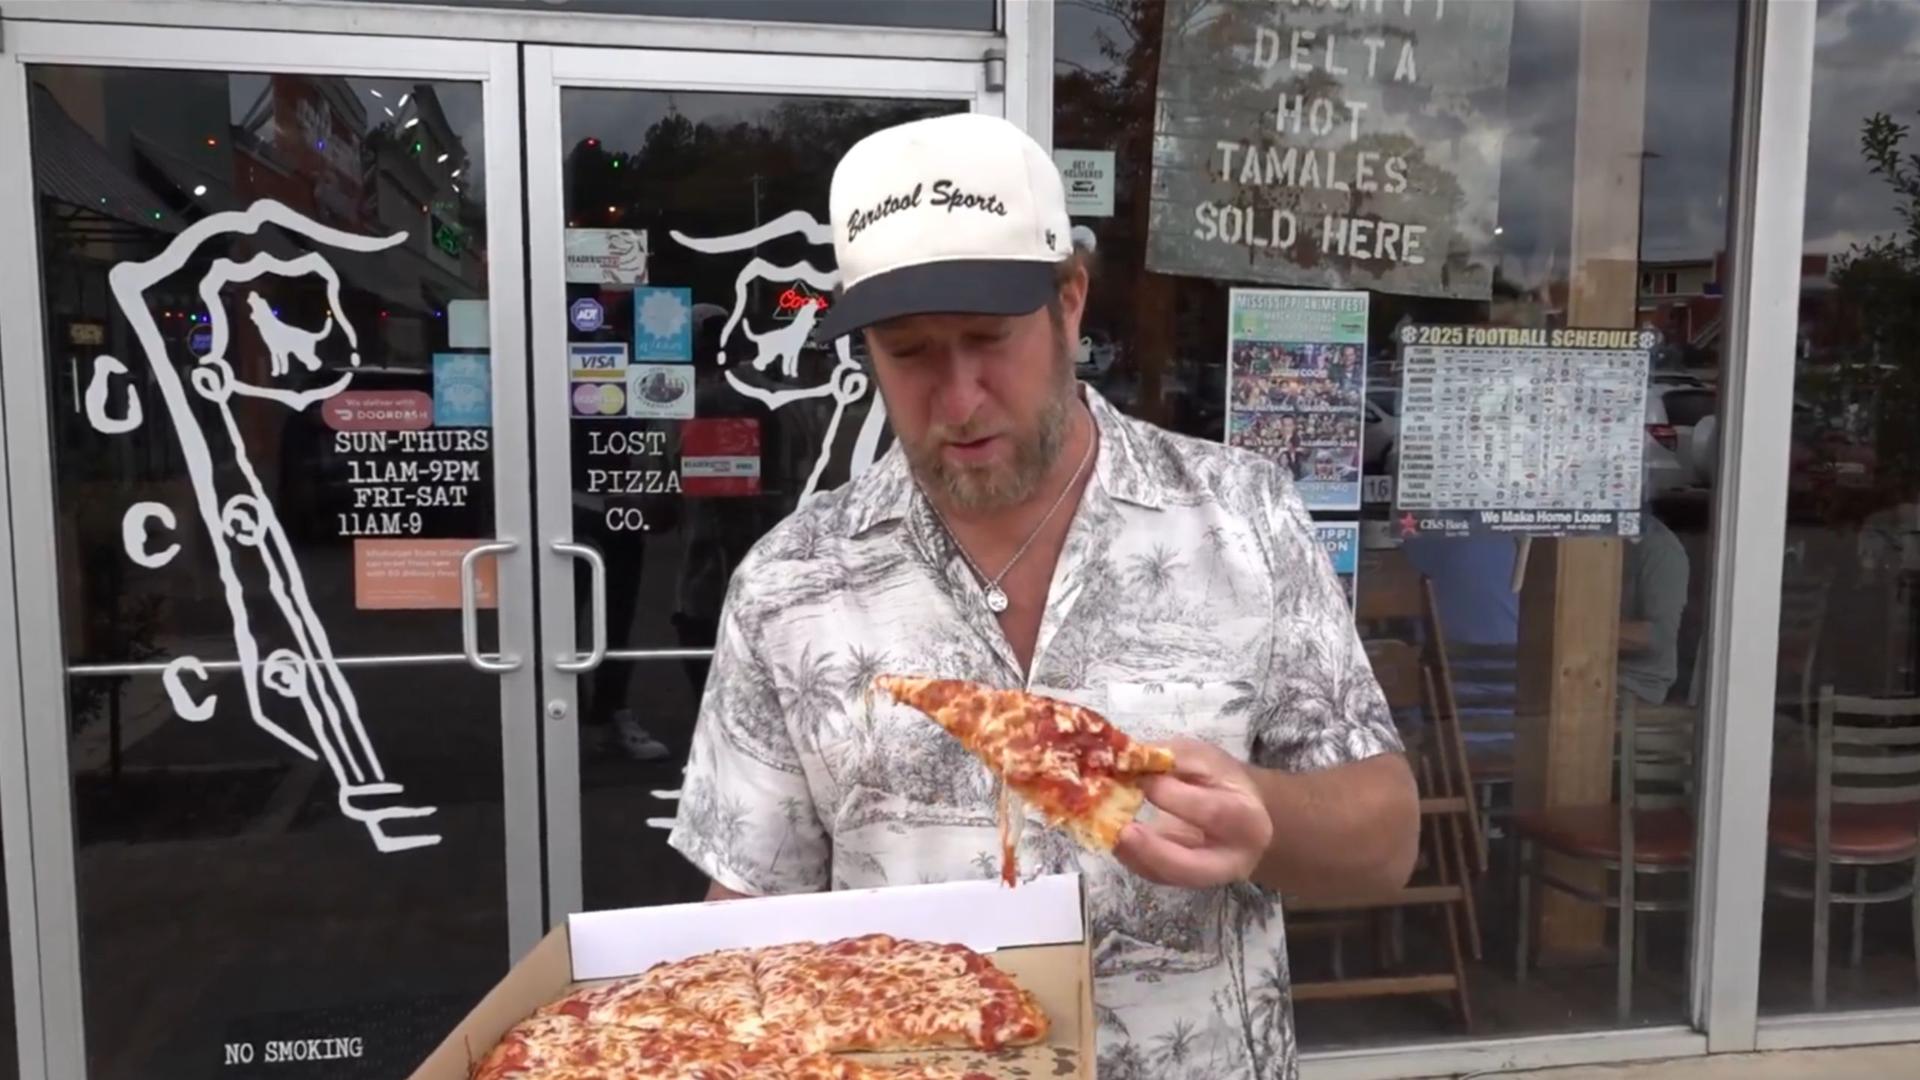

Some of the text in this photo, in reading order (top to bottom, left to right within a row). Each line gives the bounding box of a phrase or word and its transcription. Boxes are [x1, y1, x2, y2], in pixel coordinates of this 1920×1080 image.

[1253, 27, 1417, 83] DELTA
[1276, 93, 1368, 141] HOT
[1216, 140, 1409, 194] TAMALES
[847, 179, 1008, 242] Barstool Sports
[1194, 201, 1427, 264] SOLD HERE
[780, 290, 829, 309] Coos
[1418, 326, 1638, 348] 2025 FOOTBALL SCHEDULE
[581, 356, 616, 369] VISA
[357, 409, 428, 420] DOORDASH
[335, 430, 489, 453] SUN-THURS
[588, 431, 666, 455] LOST
[347, 459, 480, 483] 11AM-9PM
[587, 469, 683, 493] PIZZA
[353, 485, 468, 508] FRI-SAT
[1370, 478, 1390, 498] 16
[337, 512, 423, 536] 11AM-9
[605, 507, 651, 531] CO.
[1446, 519, 1470, 530] Bank
[1480, 510, 1612, 524] We Make Home Loans
[224, 1036, 364, 1065] NO SMOKING
